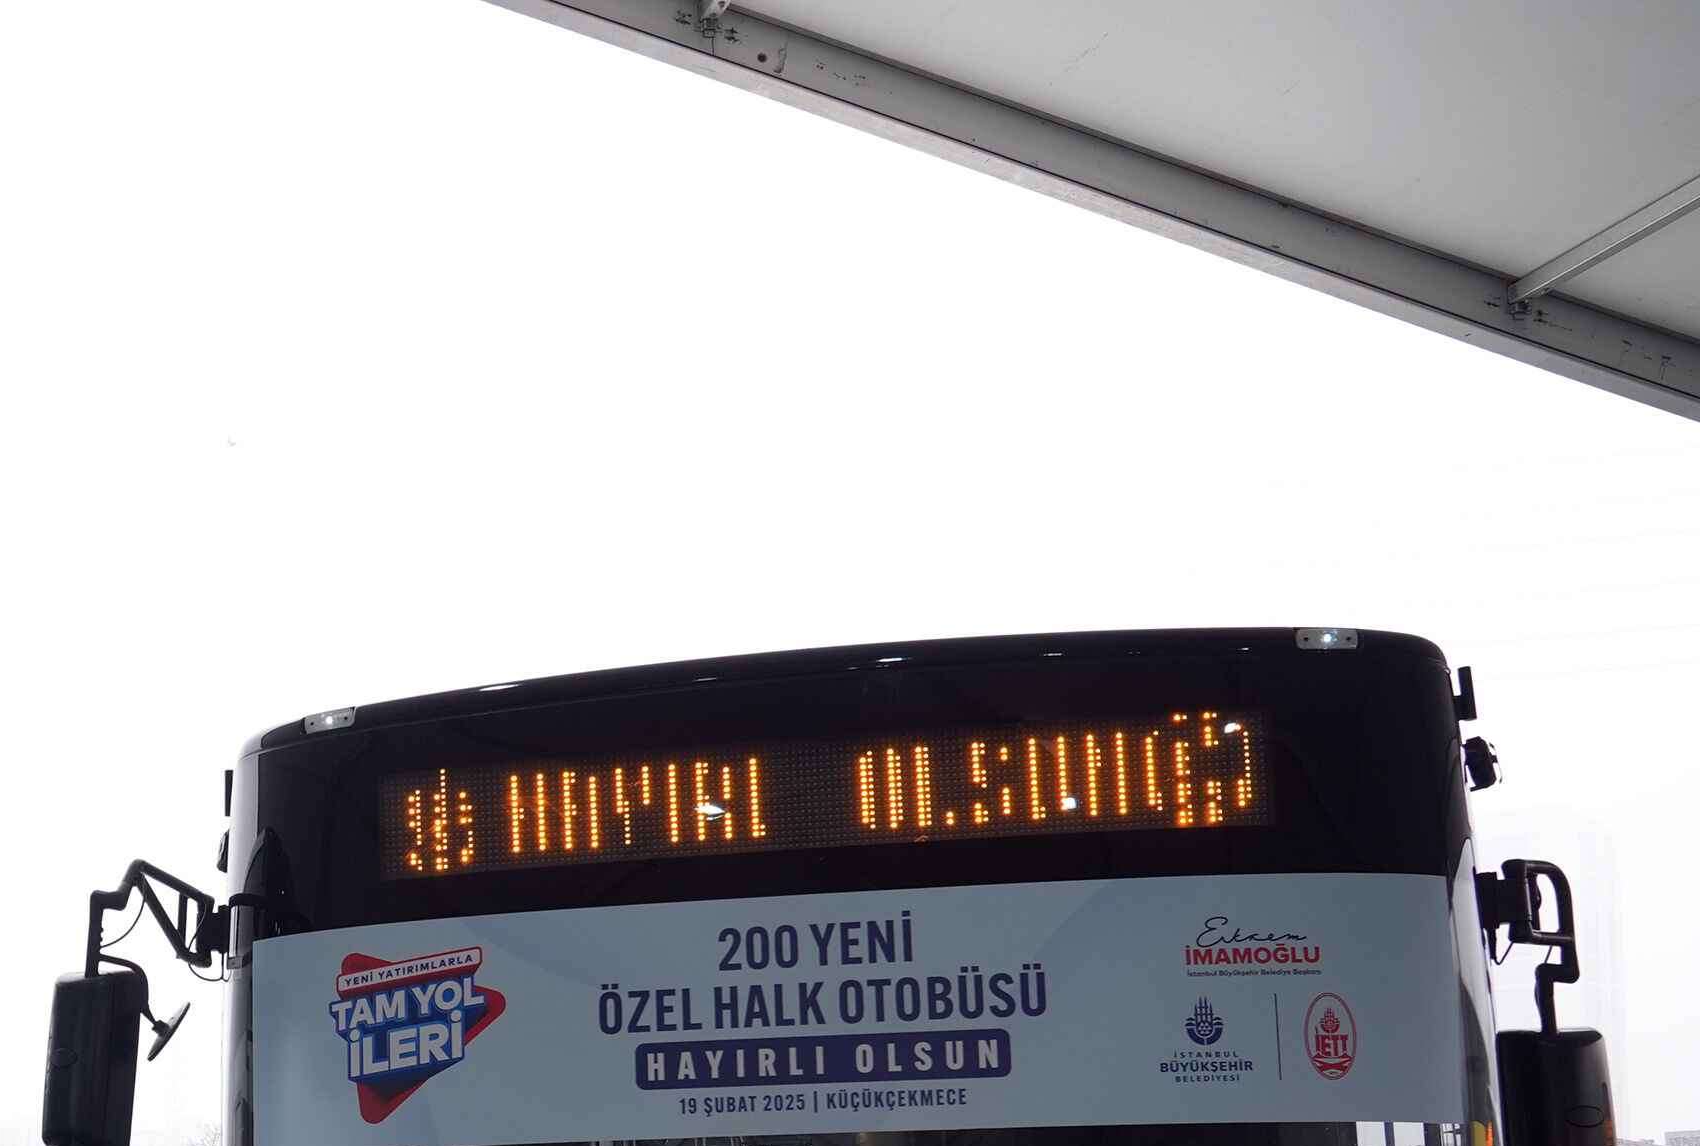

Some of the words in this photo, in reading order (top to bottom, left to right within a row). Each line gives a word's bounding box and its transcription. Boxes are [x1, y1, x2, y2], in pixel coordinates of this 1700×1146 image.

[718, 924, 799, 972] 200
[808, 910, 913, 967] YENİ
[1196, 916, 1307, 948] Ekrem
[345, 971, 373, 987] YENİ
[378, 954, 473, 980] YATIRIMLARLA
[1185, 943, 1321, 966] İMAMOĞLU
[1187, 969, 1217, 978] İstanbul
[1218, 969, 1259, 978] Büyükşehir
[1260, 968, 1291, 977] Belediye
[331, 989, 406, 1031] TAM
[412, 977, 484, 1015] YOL
[599, 983, 702, 1035] ÖZEL
[714, 981, 826, 1030] HALK
[838, 963, 1046, 1024] OTOBÜSÜ
[349, 1009, 463, 1077] İLERİ
[1174, 1051, 1238, 1059] İSTANBUL
[646, 1045, 826, 1081] HAYIRLI
[855, 1039, 999, 1073] OLSUN
[1160, 1058, 1253, 1073] BÜYÜKŞEHİR
[1175, 1074, 1240, 1083] BELEDİYESİ
[679, 1098, 697, 1115] 19
[704, 1095, 757, 1117] ŞUBAT
[763, 1093, 806, 1112] 2025
[826, 1088, 967, 1114] KÜÇÜKÇEKMECE
